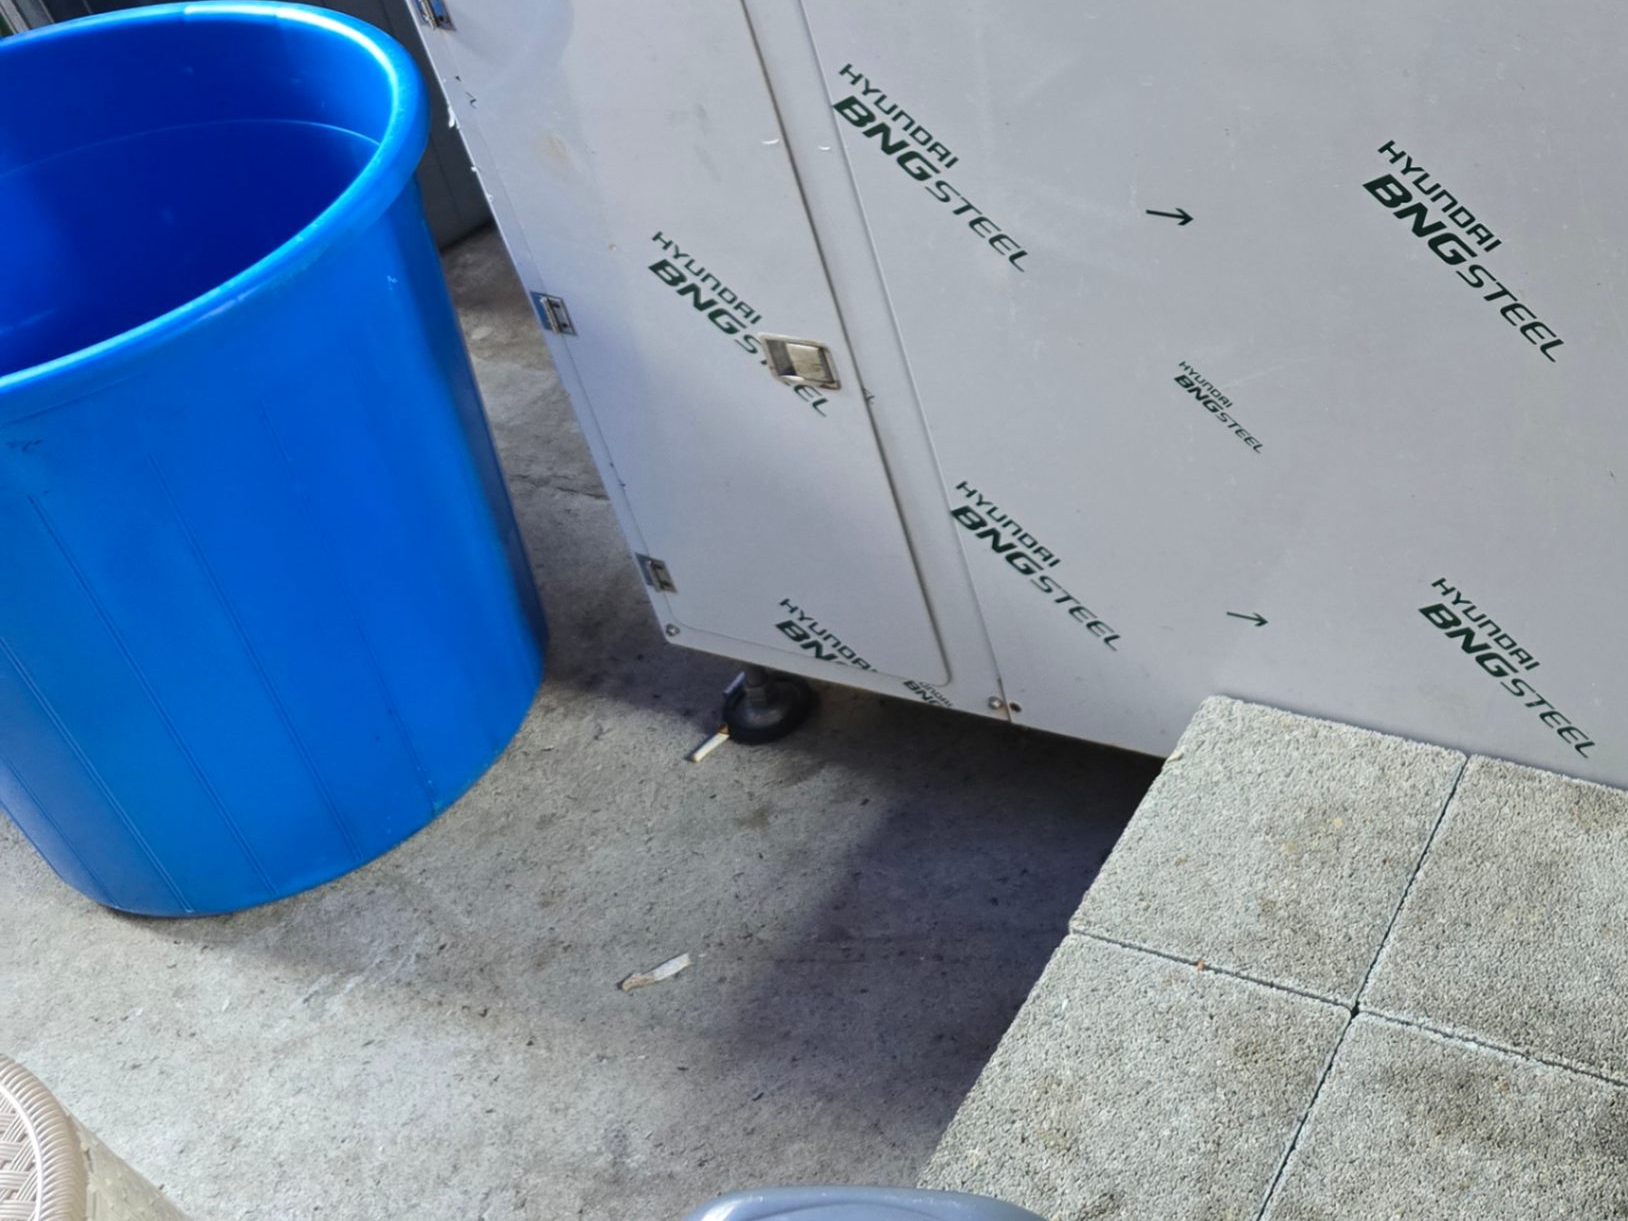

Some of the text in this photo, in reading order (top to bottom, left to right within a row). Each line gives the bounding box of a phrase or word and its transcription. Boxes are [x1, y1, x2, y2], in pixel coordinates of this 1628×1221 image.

[838, 63, 959, 169] HYUNDAI
[1377, 140, 1502, 253] HYUNDAI
[652, 231, 762, 325] HYUNDAI
[1178, 361, 1233, 409] HYUNDAI
[955, 481, 1062, 569] HYUNDAI
[780, 599, 879, 673] HYUNDA
[1431, 577, 1541, 671] HYUNDAI
